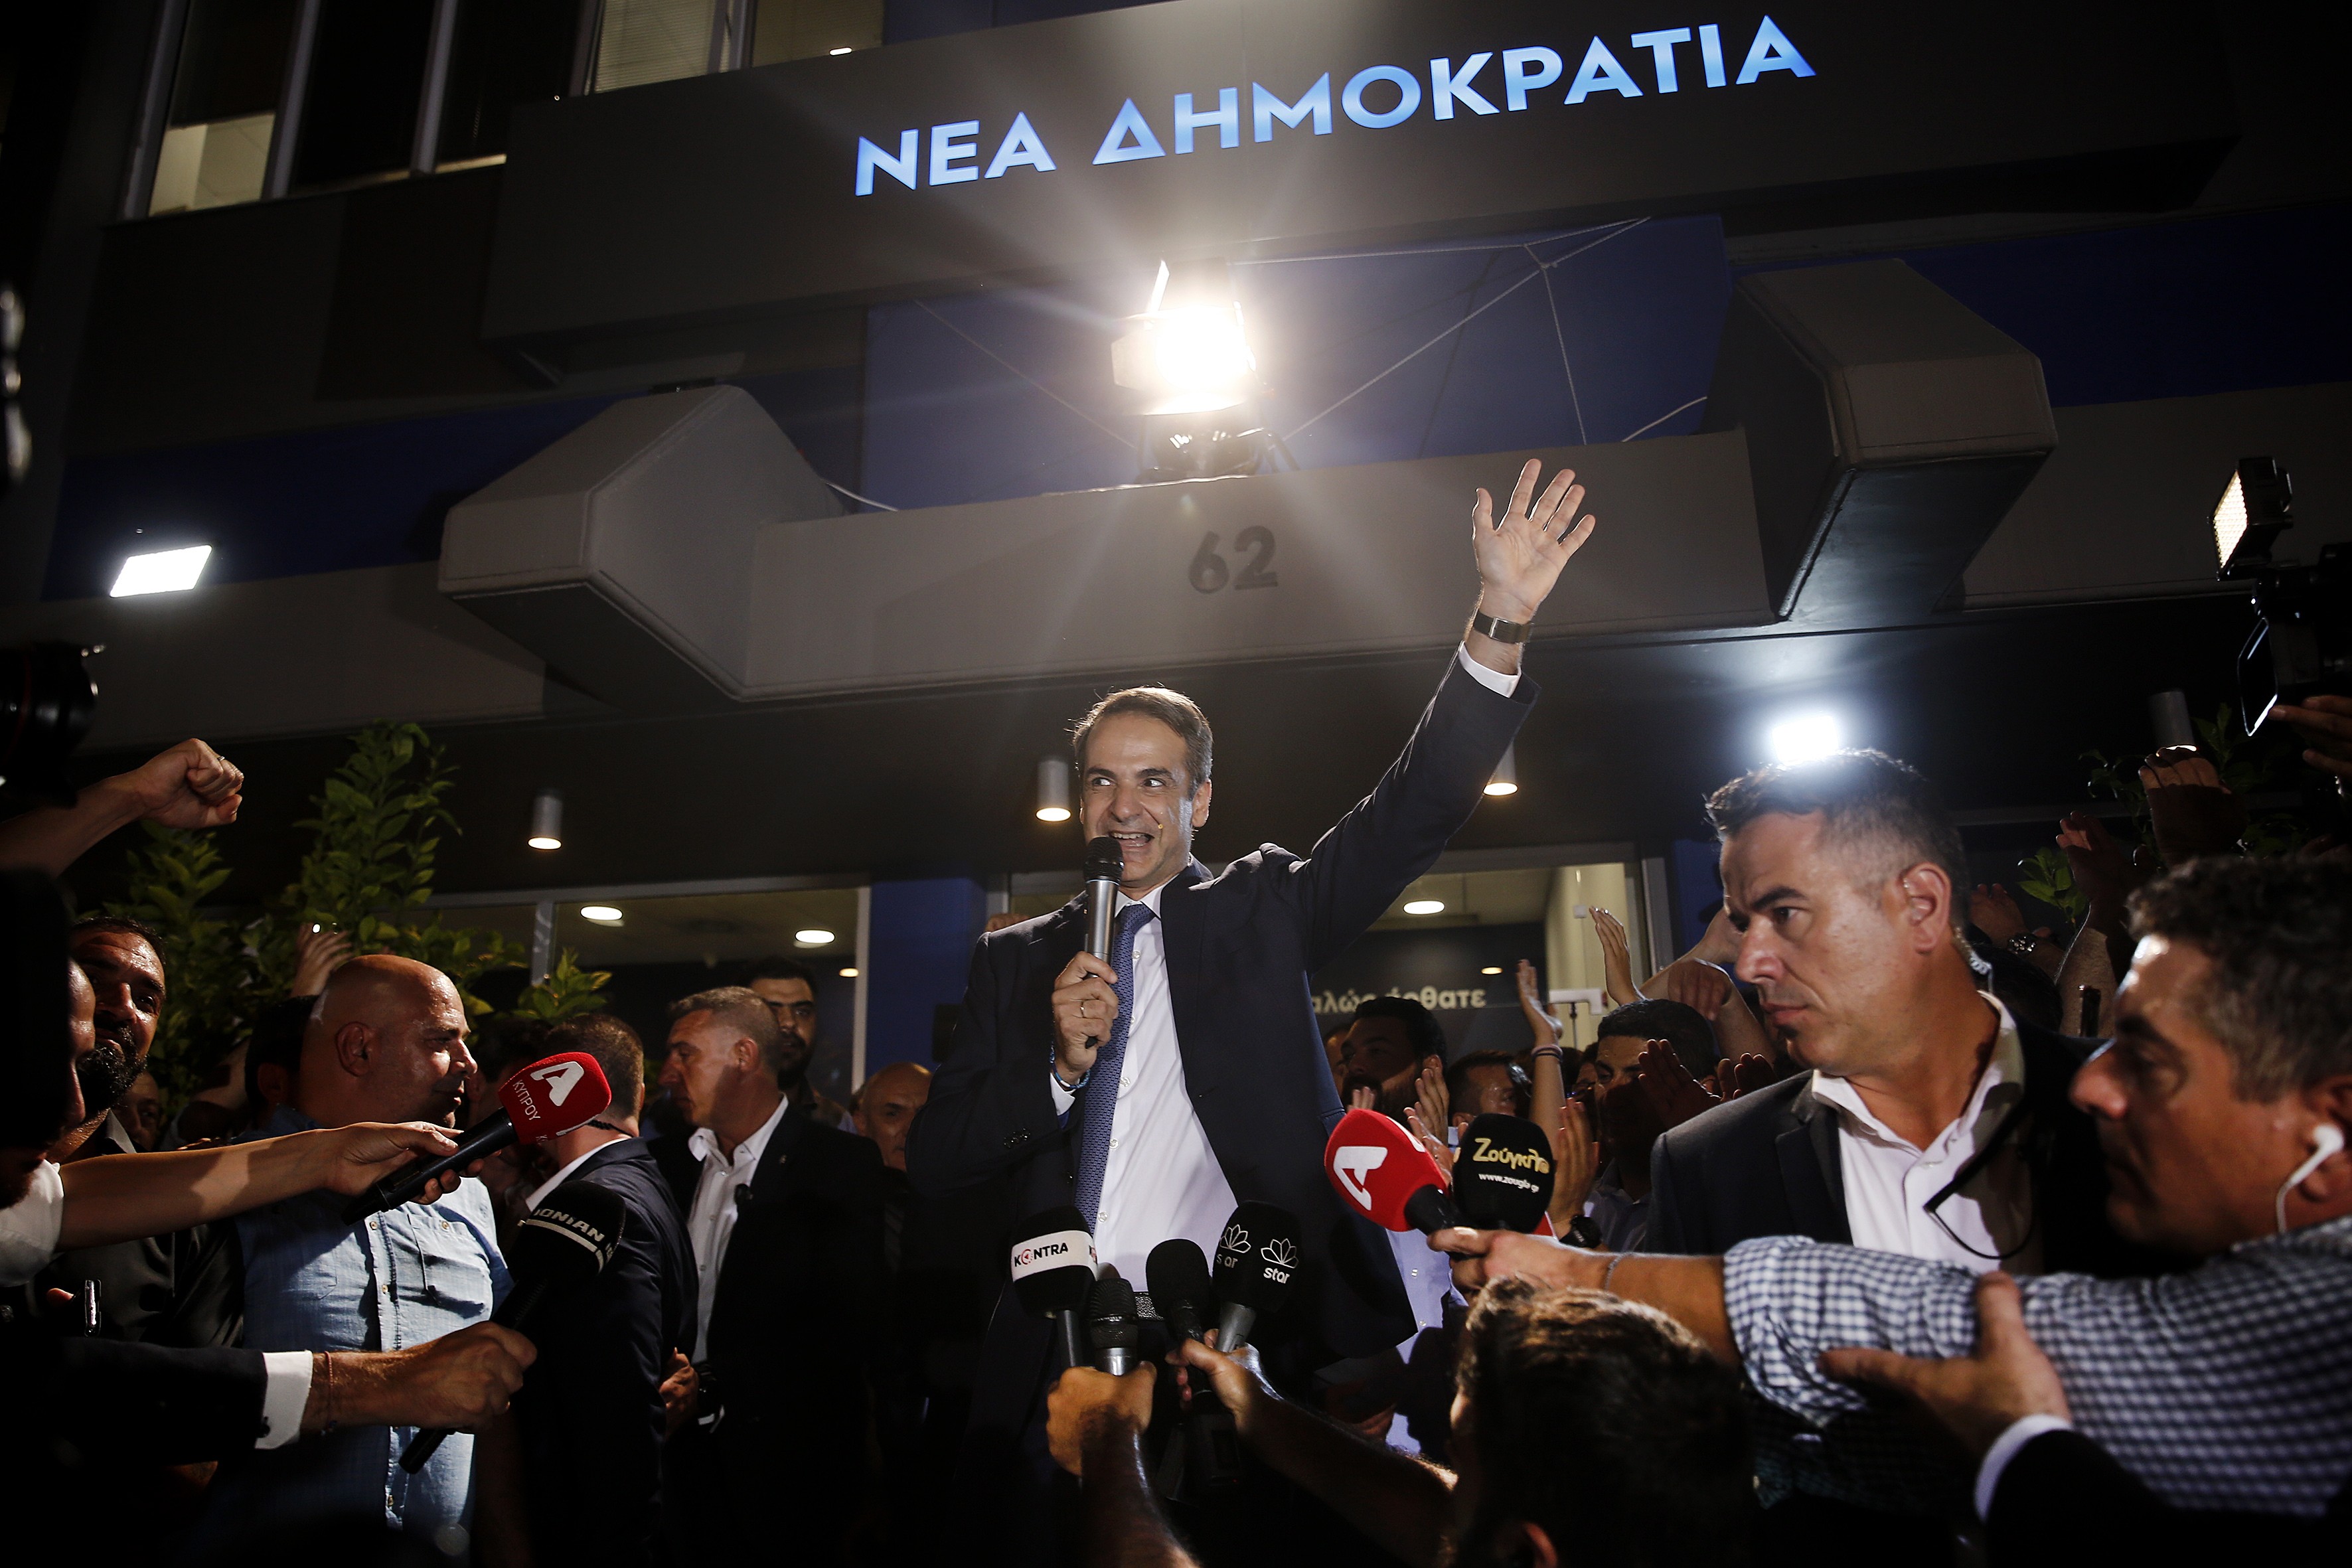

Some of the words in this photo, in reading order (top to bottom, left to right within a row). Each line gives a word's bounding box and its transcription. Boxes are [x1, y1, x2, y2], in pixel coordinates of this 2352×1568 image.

[854, 111, 1057, 197] ΝΕΑ
[1092, 15, 1817, 166] ΔΗΜΟΚΡΑΤΙΑ
[1188, 525, 1279, 594] 62
[512, 1079, 541, 1121] ΚΥΠΡΟΥ
[1263, 1267, 1291, 1284] star
